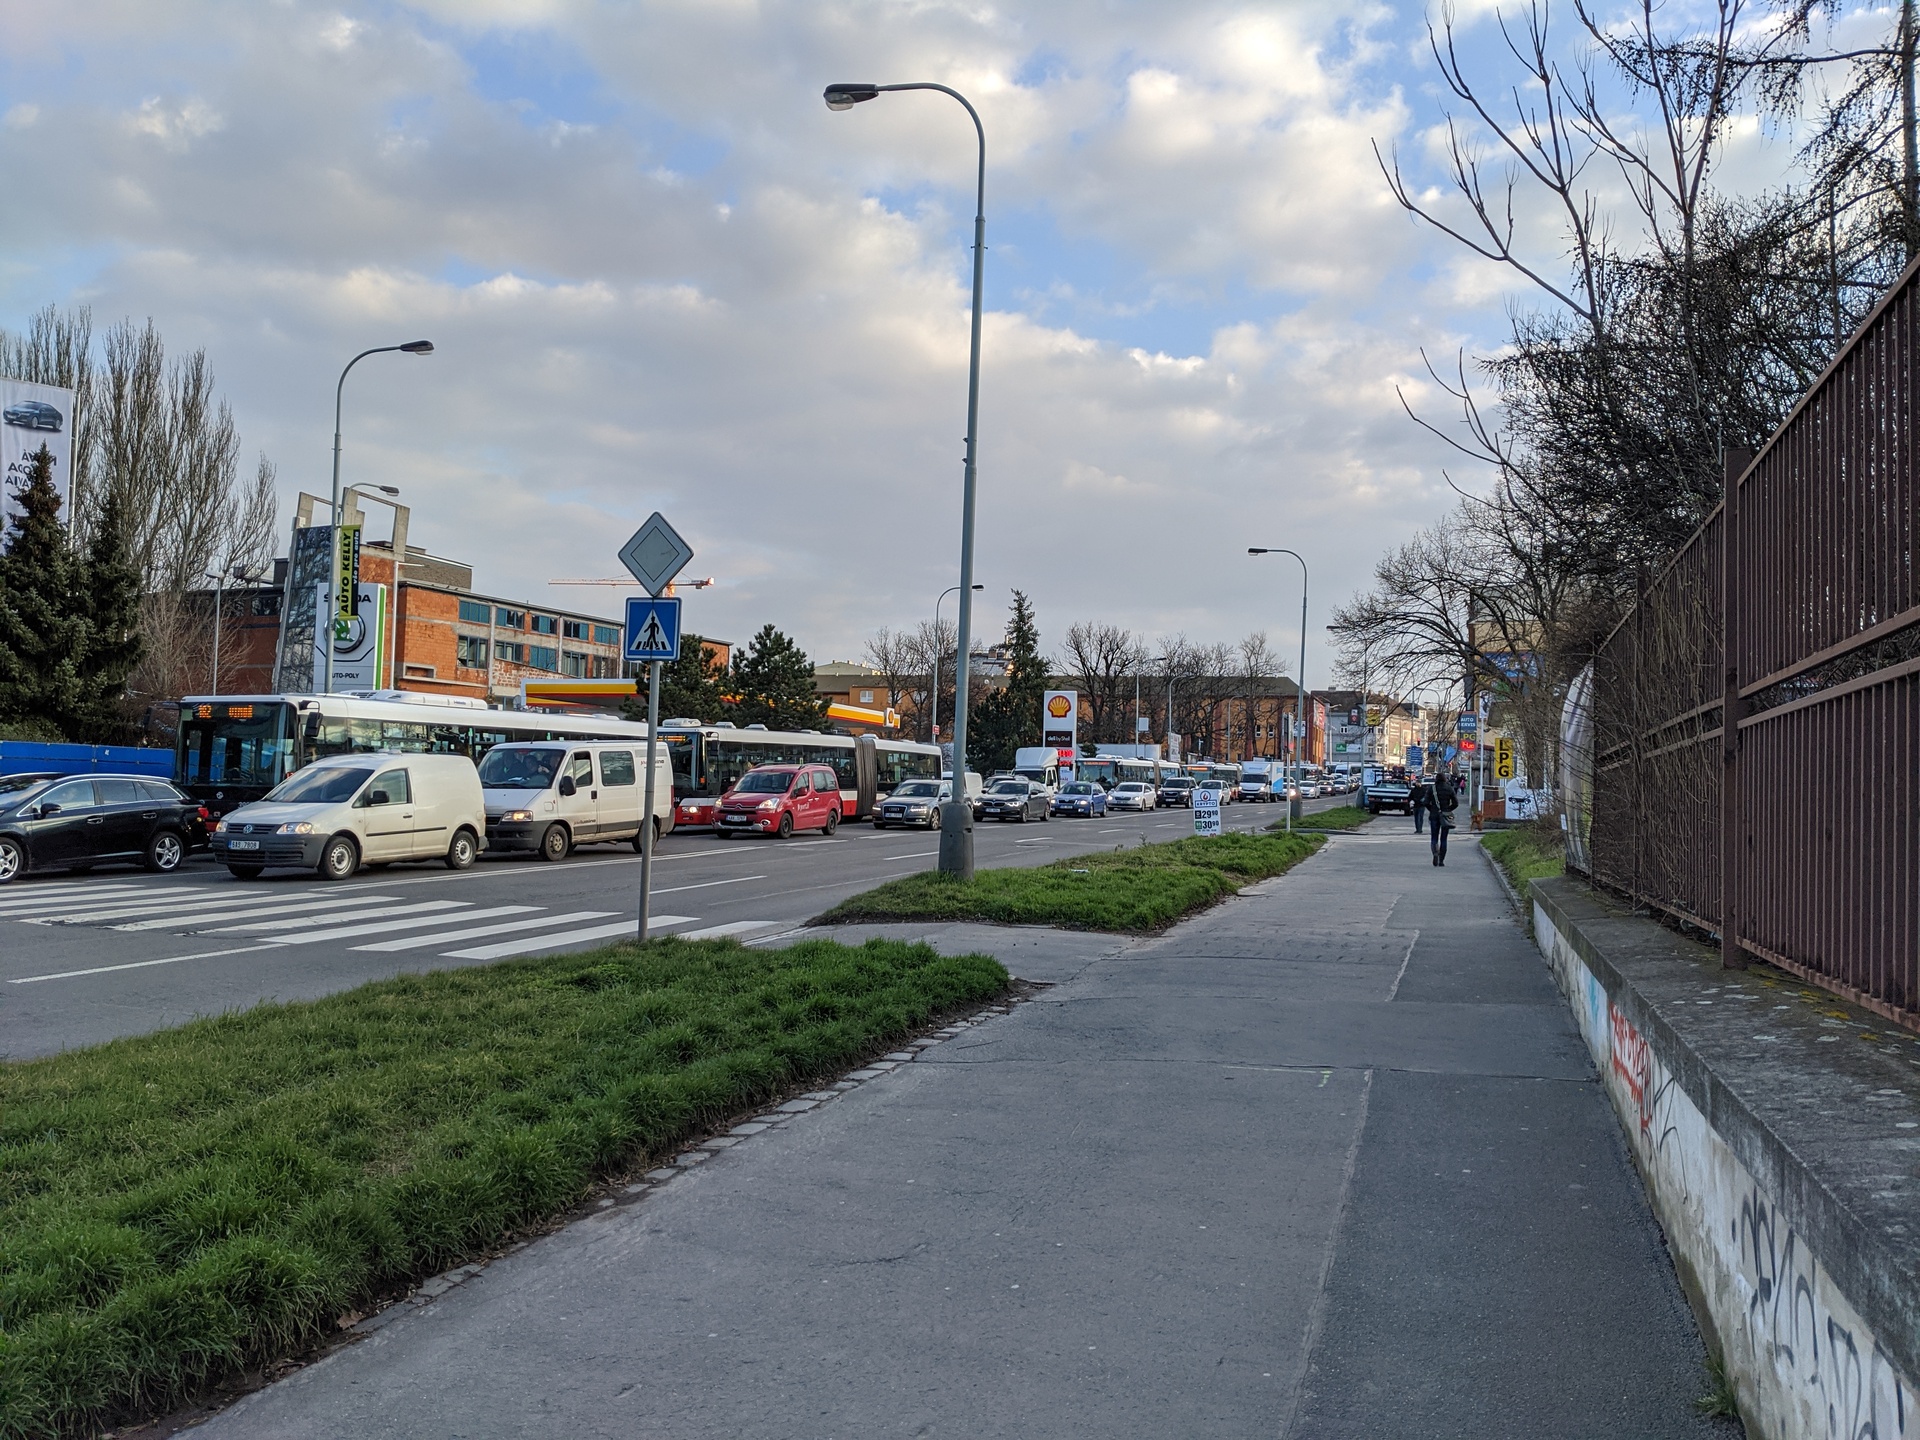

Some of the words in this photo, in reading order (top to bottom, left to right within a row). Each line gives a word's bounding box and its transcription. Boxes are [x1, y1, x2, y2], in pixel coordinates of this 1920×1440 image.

[342, 532, 351, 571] KELLY
[323, 591, 372, 603] ŠKDA
[341, 576, 350, 614] AUTO
[1498, 740, 1510, 777] LPG
